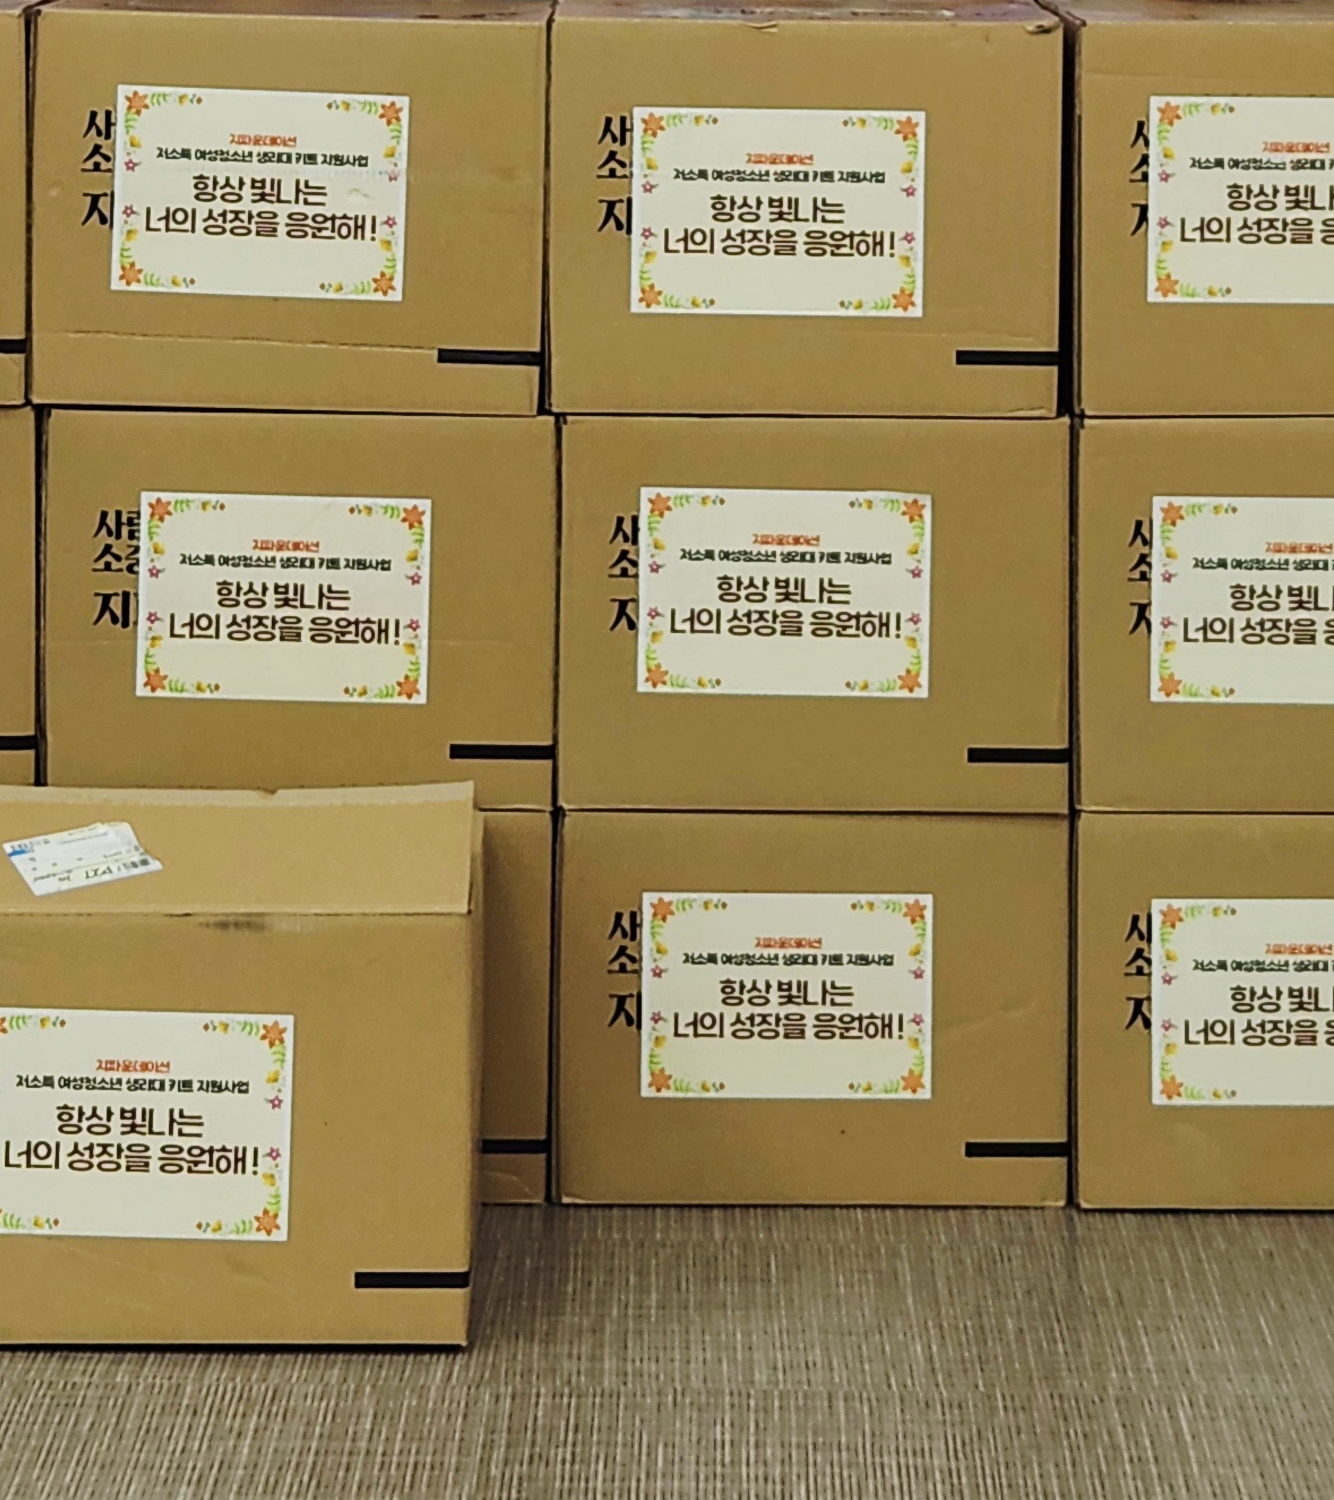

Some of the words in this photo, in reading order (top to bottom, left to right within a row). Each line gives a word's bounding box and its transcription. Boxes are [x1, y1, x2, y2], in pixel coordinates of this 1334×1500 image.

[192, 173, 246, 204] 항상
[249, 176, 328, 207] 빛나는
[1226, 182, 1280, 212] 항상
[145, 206, 197, 234] 너의
[202, 208, 280, 238] 성장을
[284, 211, 377, 242] 응원해!
[710, 193, 764, 224] 항상
[767, 196, 846, 224] 빛나는
[663, 227, 715, 255] 너의
[720, 228, 799, 257] 성장을
[802, 229, 896, 258] 응원해!
[1179, 216, 1232, 244] 너의
[1236, 216, 1315, 245] 성장을
[215, 579, 270, 609] 항상
[273, 582, 351, 611] 빛나는
[716, 574, 770, 604] 항상
[774, 576, 852, 606] 빛나는
[1229, 583, 1283, 613] 항상
[169, 612, 221, 640] 너의
[225, 613, 304, 643] 성장을
[307, 616, 401, 646] 응원해!
[669, 607, 722, 635] 너의
[726, 608, 804, 638] 성장을
[809, 610, 902, 639] 응원해!
[1182, 616, 1235, 644] 너의
[1239, 617, 1318, 646] 성장을
[719, 977, 773, 1007] 항상
[776, 979, 855, 1007] 빛나는
[1229, 984, 1284, 1014] 항상
[672, 1011, 725, 1039] 너의
[729, 1011, 807, 1040] 성장을
[812, 1012, 904, 1041] 응원해!
[1184, 1018, 1236, 1046] 너의
[1240, 1018, 1319, 1047] 성장을
[56, 1103, 115, 1136] 항상
[119, 1106, 205, 1138] 빛나는
[4, 1140, 61, 1170] 너의
[66, 1141, 152, 1173] 성장을
[157, 1144, 259, 1176] 응원해!
